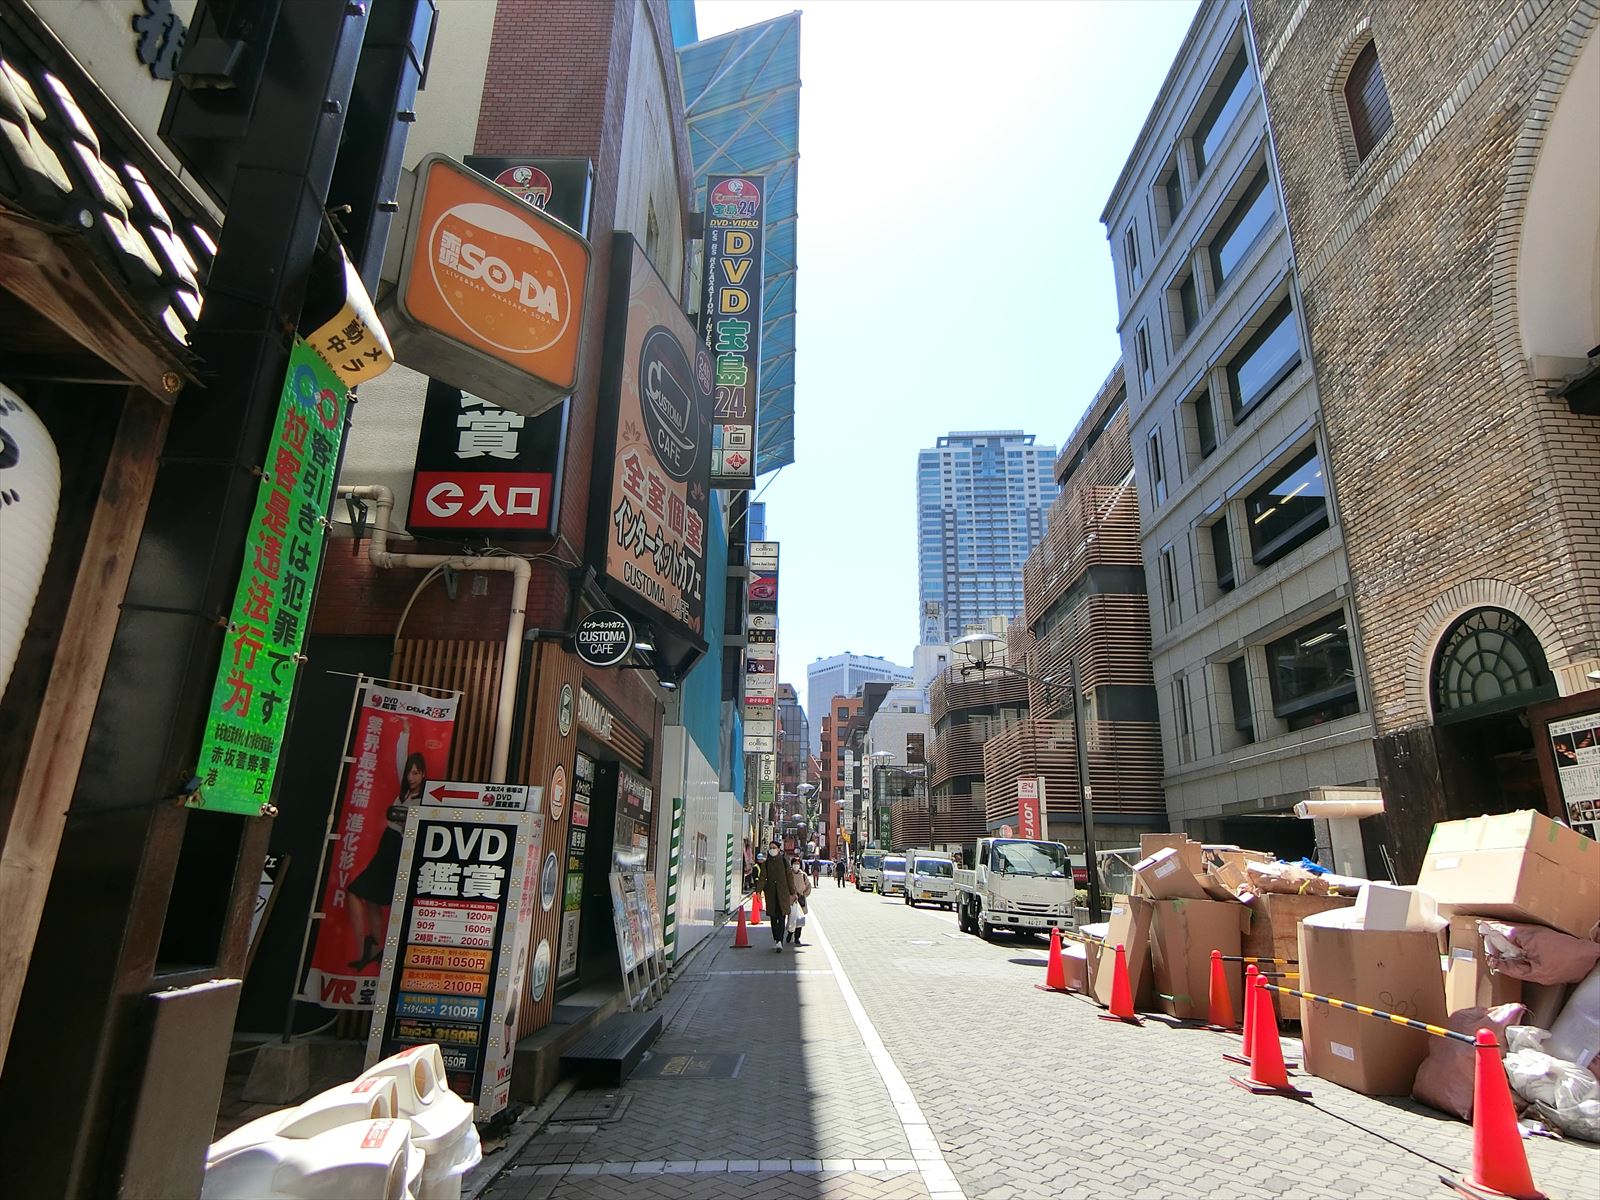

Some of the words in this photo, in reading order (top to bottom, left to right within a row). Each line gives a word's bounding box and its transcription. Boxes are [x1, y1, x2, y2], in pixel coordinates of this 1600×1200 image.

[718, 229, 754, 316] DVD
[716, 318, 751, 386] 宝島
[715, 386, 747, 418] 24
[657, 429, 681, 467] CAFE
[468, 484, 541, 517] 入口
[623, 454, 703, 555] 全室個室
[614, 496, 702, 600] インターネットカフェ
[623, 561, 666, 605] CUSTOMA
[579, 631, 626, 642] CUSTOMA
[590, 643, 614, 655] CAFE
[211, 746, 270, 775] 赤坂警察署
[349, 715, 384, 808] 業界最先端
[423, 825, 508, 862] DVD
[416, 861, 506, 900] 鑑賞
[416, 921, 435, 930] 90分
[464, 925, 491, 934] 1600円
[418, 909, 437, 918] 60分
[466, 912, 492, 922] 1200円
[414, 933, 433, 942] 2時間
[460, 937, 489, 947] 2000円
[411, 954, 443, 966] 3時間
[447, 957, 485, 969] 1050円
[320, 975, 357, 1004] VR
[443, 980, 482, 993] 2100円
[439, 1004, 479, 1017] 2100円
